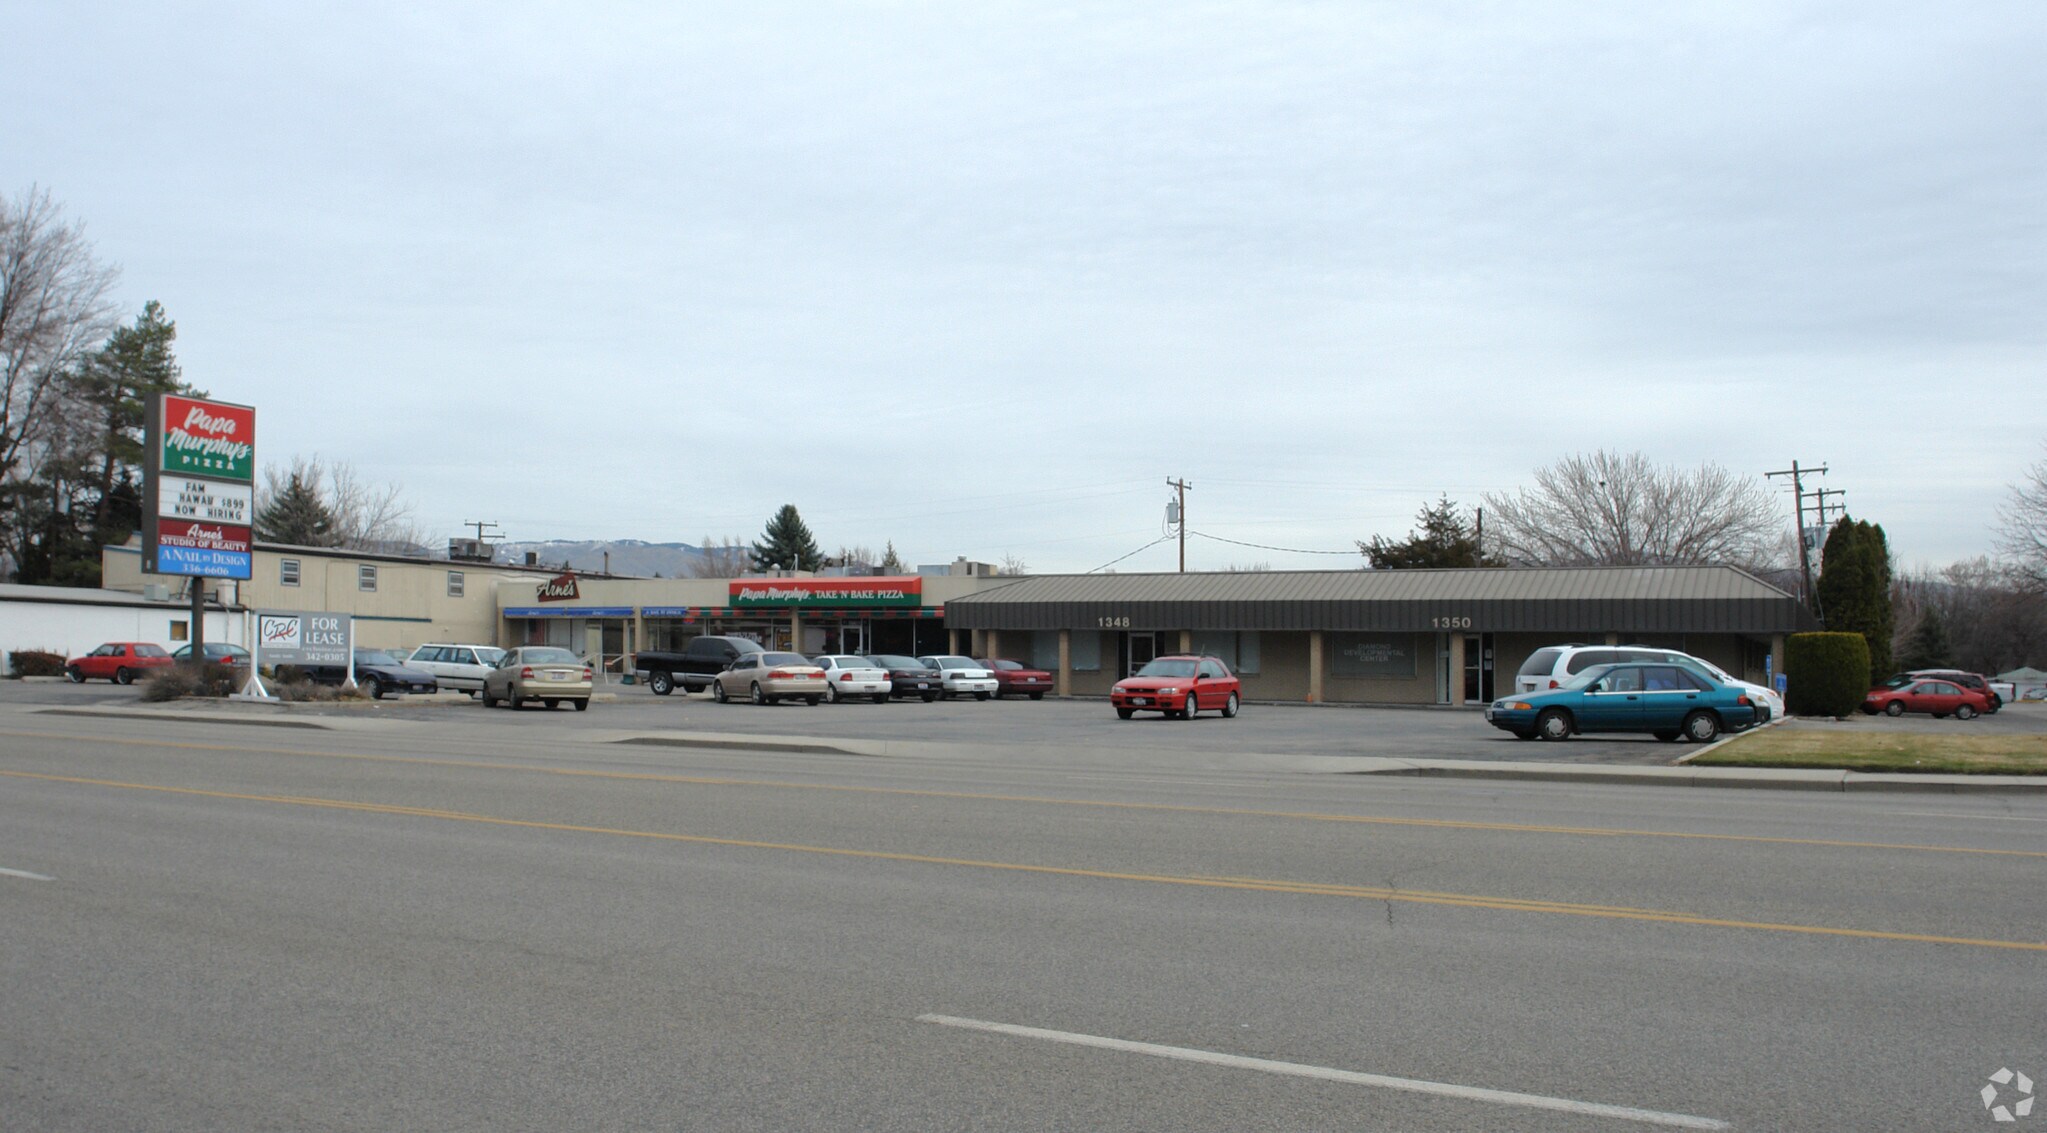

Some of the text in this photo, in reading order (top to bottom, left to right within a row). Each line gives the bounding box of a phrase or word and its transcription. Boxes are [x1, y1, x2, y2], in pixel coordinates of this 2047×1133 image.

[183, 405, 237, 435] Papa
[166, 426, 250, 462] Murphy's
[182, 455, 235, 471] PIZZA
[186, 482, 205, 493] FAM
[175, 504, 242, 520] NOW HIRING
[187, 523, 223, 540] Arne's
[160, 536, 247, 552] STUDIO OF BEAUTY
[162, 549, 171, 560] A
[172, 548, 201, 562] NAIL
[212, 552, 247, 566] DESIGN
[183, 563, 229, 576] 336-6606
[536, 578, 575, 597] Arne's
[739, 587, 767, 601] Papa
[767, 587, 809, 601] Murphy's
[815, 590, 838, 599] TAKE
[851, 590, 874, 599] BAKE
[877, 590, 904, 599] PIZZA
[311, 617, 338, 631] FOR
[1098, 616, 1130, 628] 1348
[1432, 616, 1472, 628] 1350
[305, 631, 344, 645] LEASE
